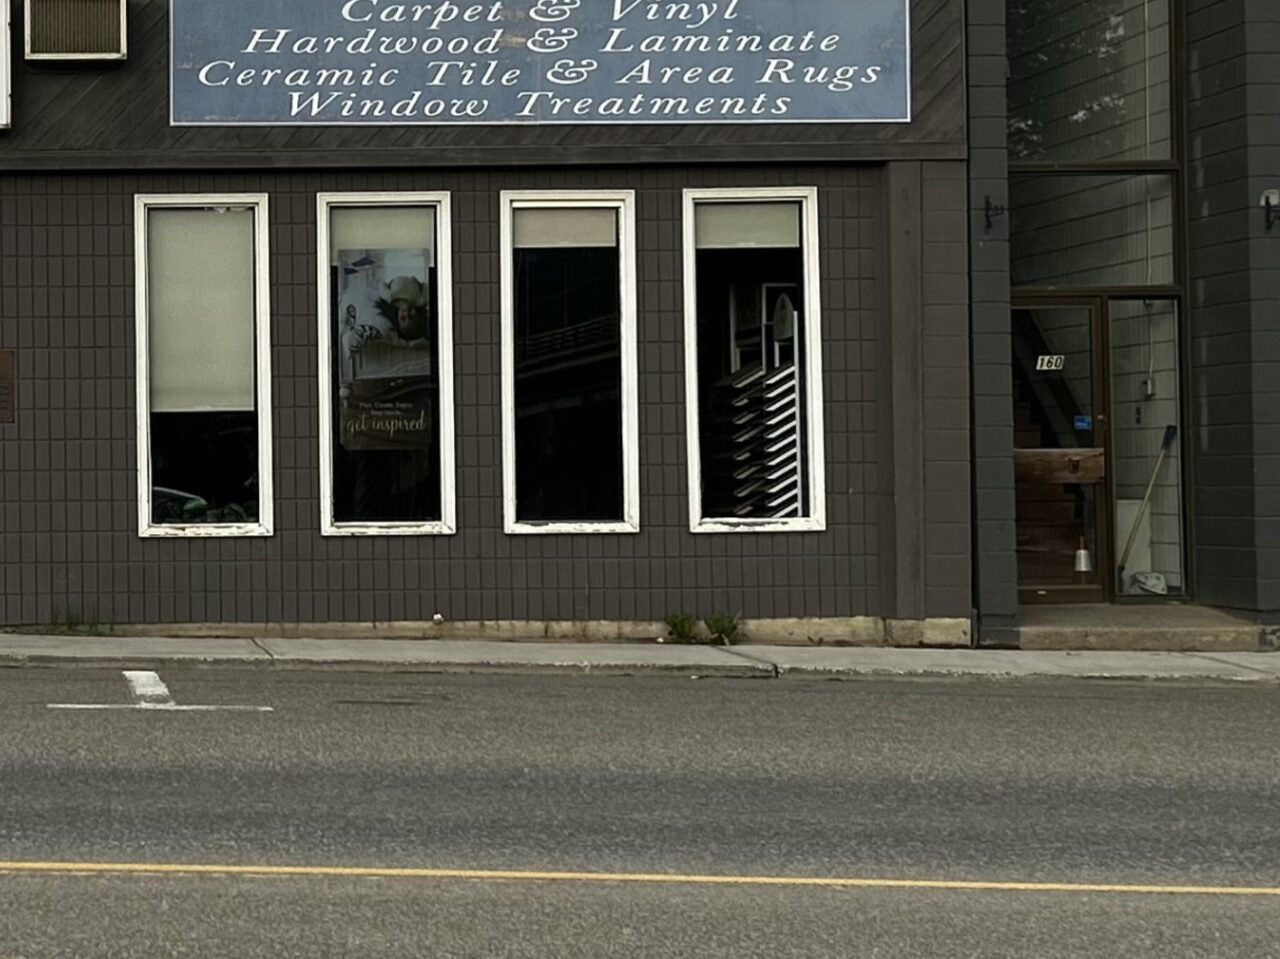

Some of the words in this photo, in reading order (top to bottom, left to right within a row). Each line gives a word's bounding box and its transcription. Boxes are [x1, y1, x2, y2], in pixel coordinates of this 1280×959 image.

[240, 28, 504, 54] Hardwood
[526, 27, 578, 53] &
[598, 28, 841, 53] Laminate
[198, 60, 400, 86] Ceramic
[425, 60, 521, 86] Tile
[546, 59, 598, 85] &
[614, 59, 734, 85] Area
[755, 58, 882, 92] Rugs
[288, 90, 490, 117] Window
[515, 91, 792, 117] Treatments
[1039, 356, 1063, 369] 160
[371, 409, 426, 438] inspired
